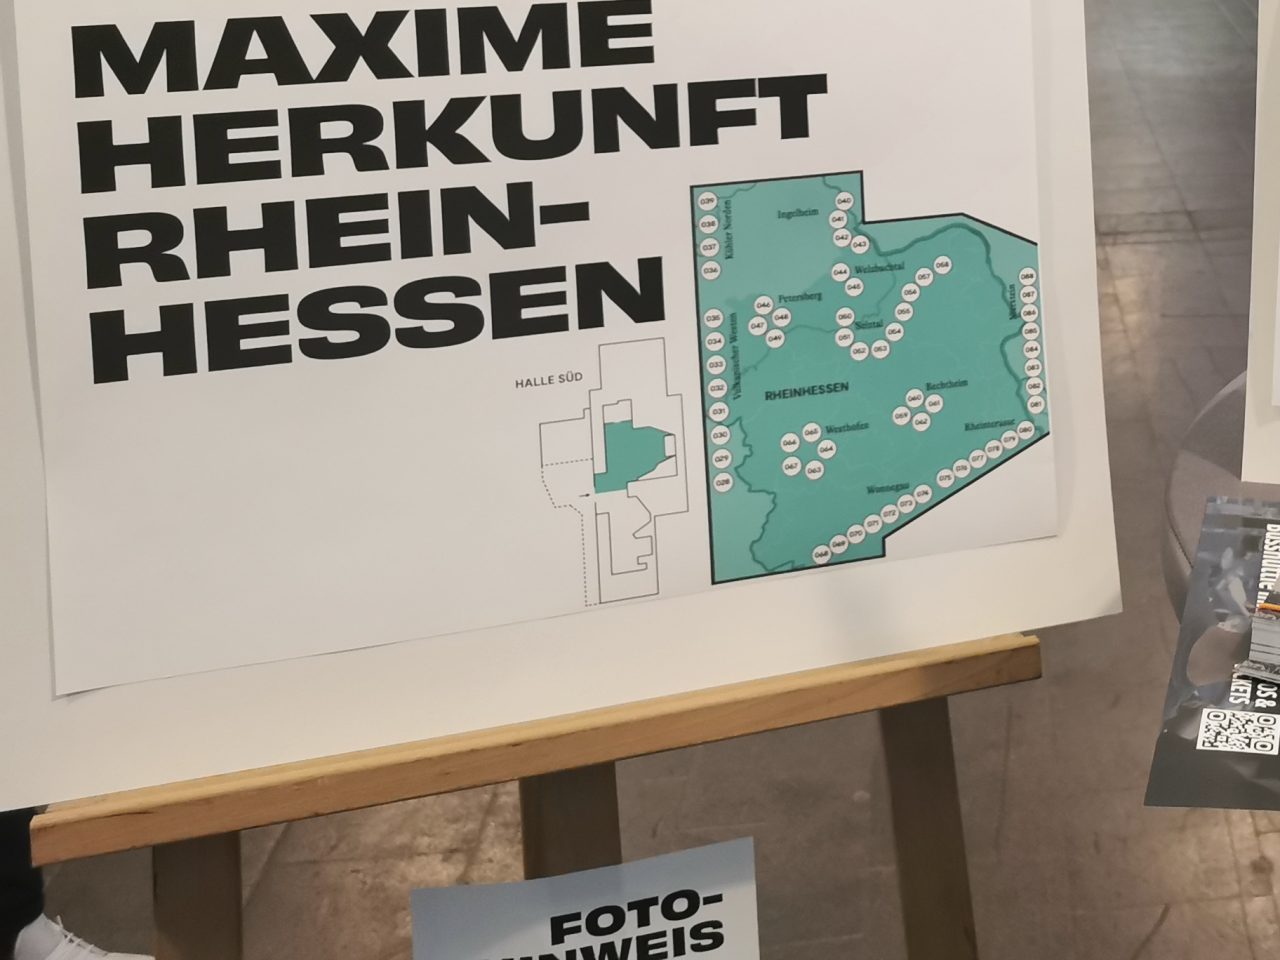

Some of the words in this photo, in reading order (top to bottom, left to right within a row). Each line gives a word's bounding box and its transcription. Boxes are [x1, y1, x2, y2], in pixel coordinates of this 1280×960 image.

[77, 74, 829, 193] HERKUNFT
[83, 182, 590, 289] RHEIN-
[90, 257, 666, 384] HESSEN
[515, 375, 555, 389] HALLE
[558, 371, 584, 384] SÜD
[765, 381, 849, 401] RHEINHESSEN
[549, 889, 724, 946] FOTO-
